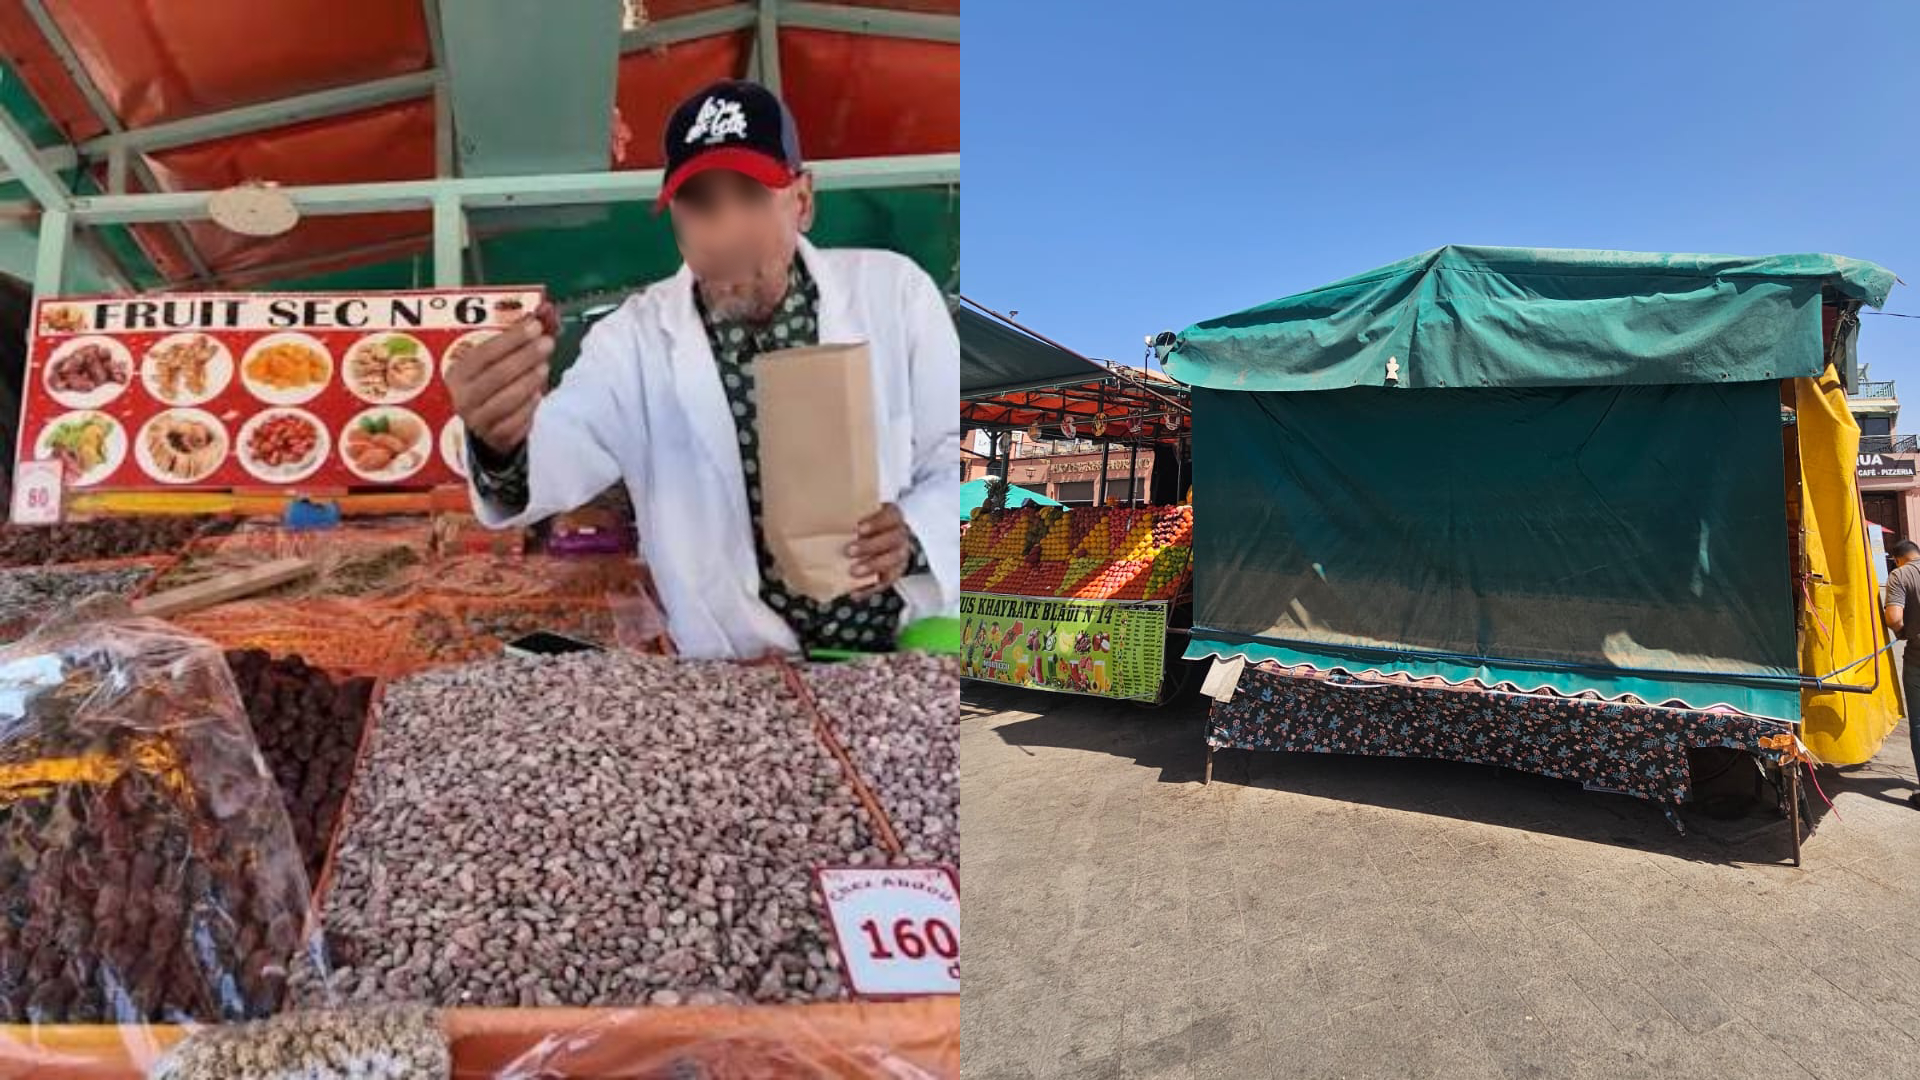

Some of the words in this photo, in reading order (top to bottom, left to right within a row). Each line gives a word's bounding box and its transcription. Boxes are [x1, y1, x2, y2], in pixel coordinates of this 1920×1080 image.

[95, 300, 248, 330] FRUIT
[267, 299, 369, 328] SEC
[390, 296, 488, 326] N°6
[1856, 453, 1884, 467] UA
[1881, 468, 1914, 476] PIZZERIA
[977, 597, 1041, 619] KHAYRATE
[1041, 602, 1082, 622] BLADI
[861, 918, 959, 959] 160
